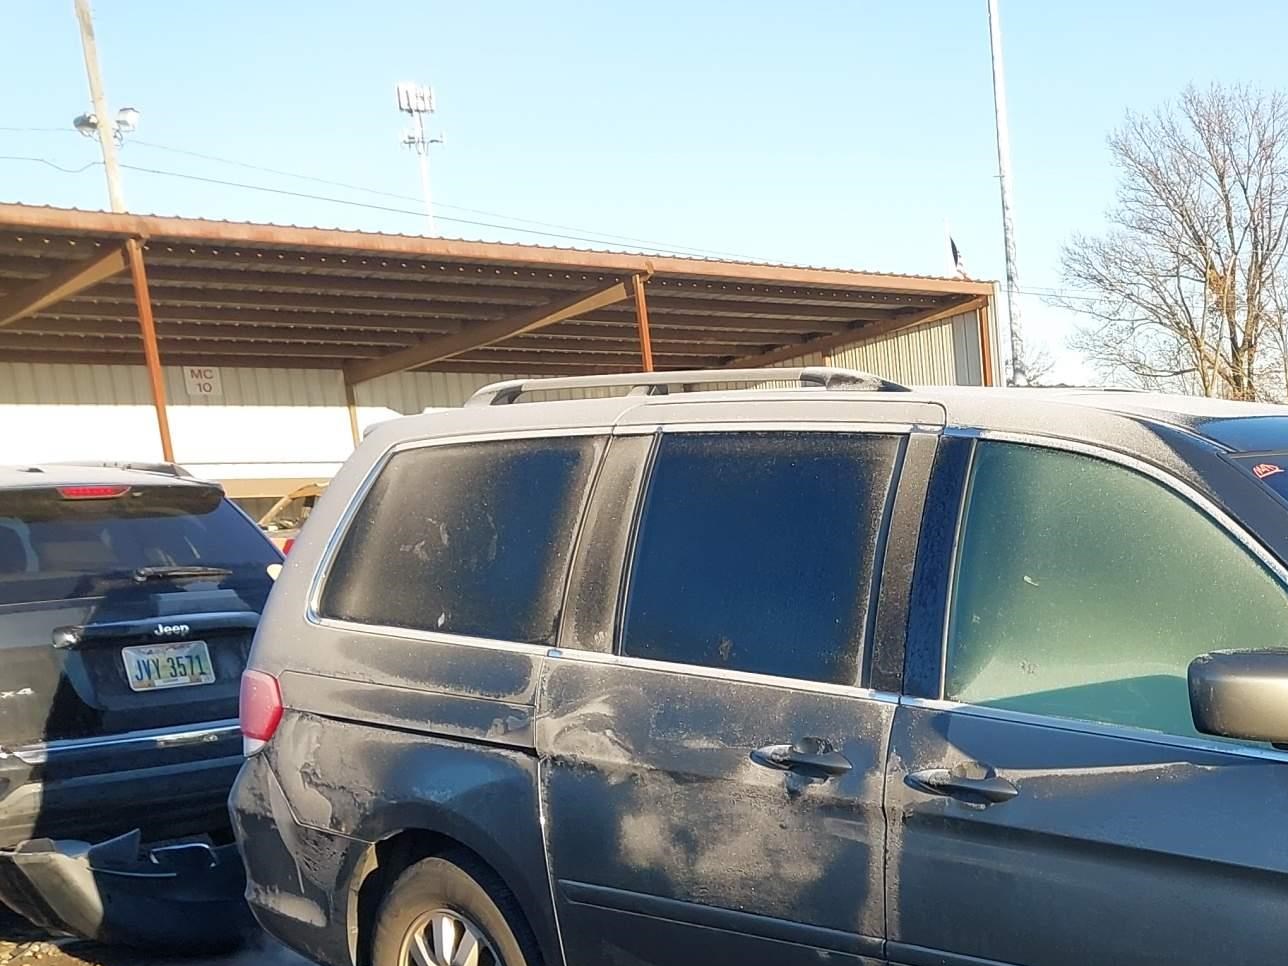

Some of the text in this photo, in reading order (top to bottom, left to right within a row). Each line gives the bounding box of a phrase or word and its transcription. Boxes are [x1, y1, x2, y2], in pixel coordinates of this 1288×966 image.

[190, 369, 214, 380] MC
[195, 382, 213, 393] 10
[153, 624, 190, 636] Jeep
[135, 654, 206, 681] JVY 3571
[0, 687, 35, 699] x4
